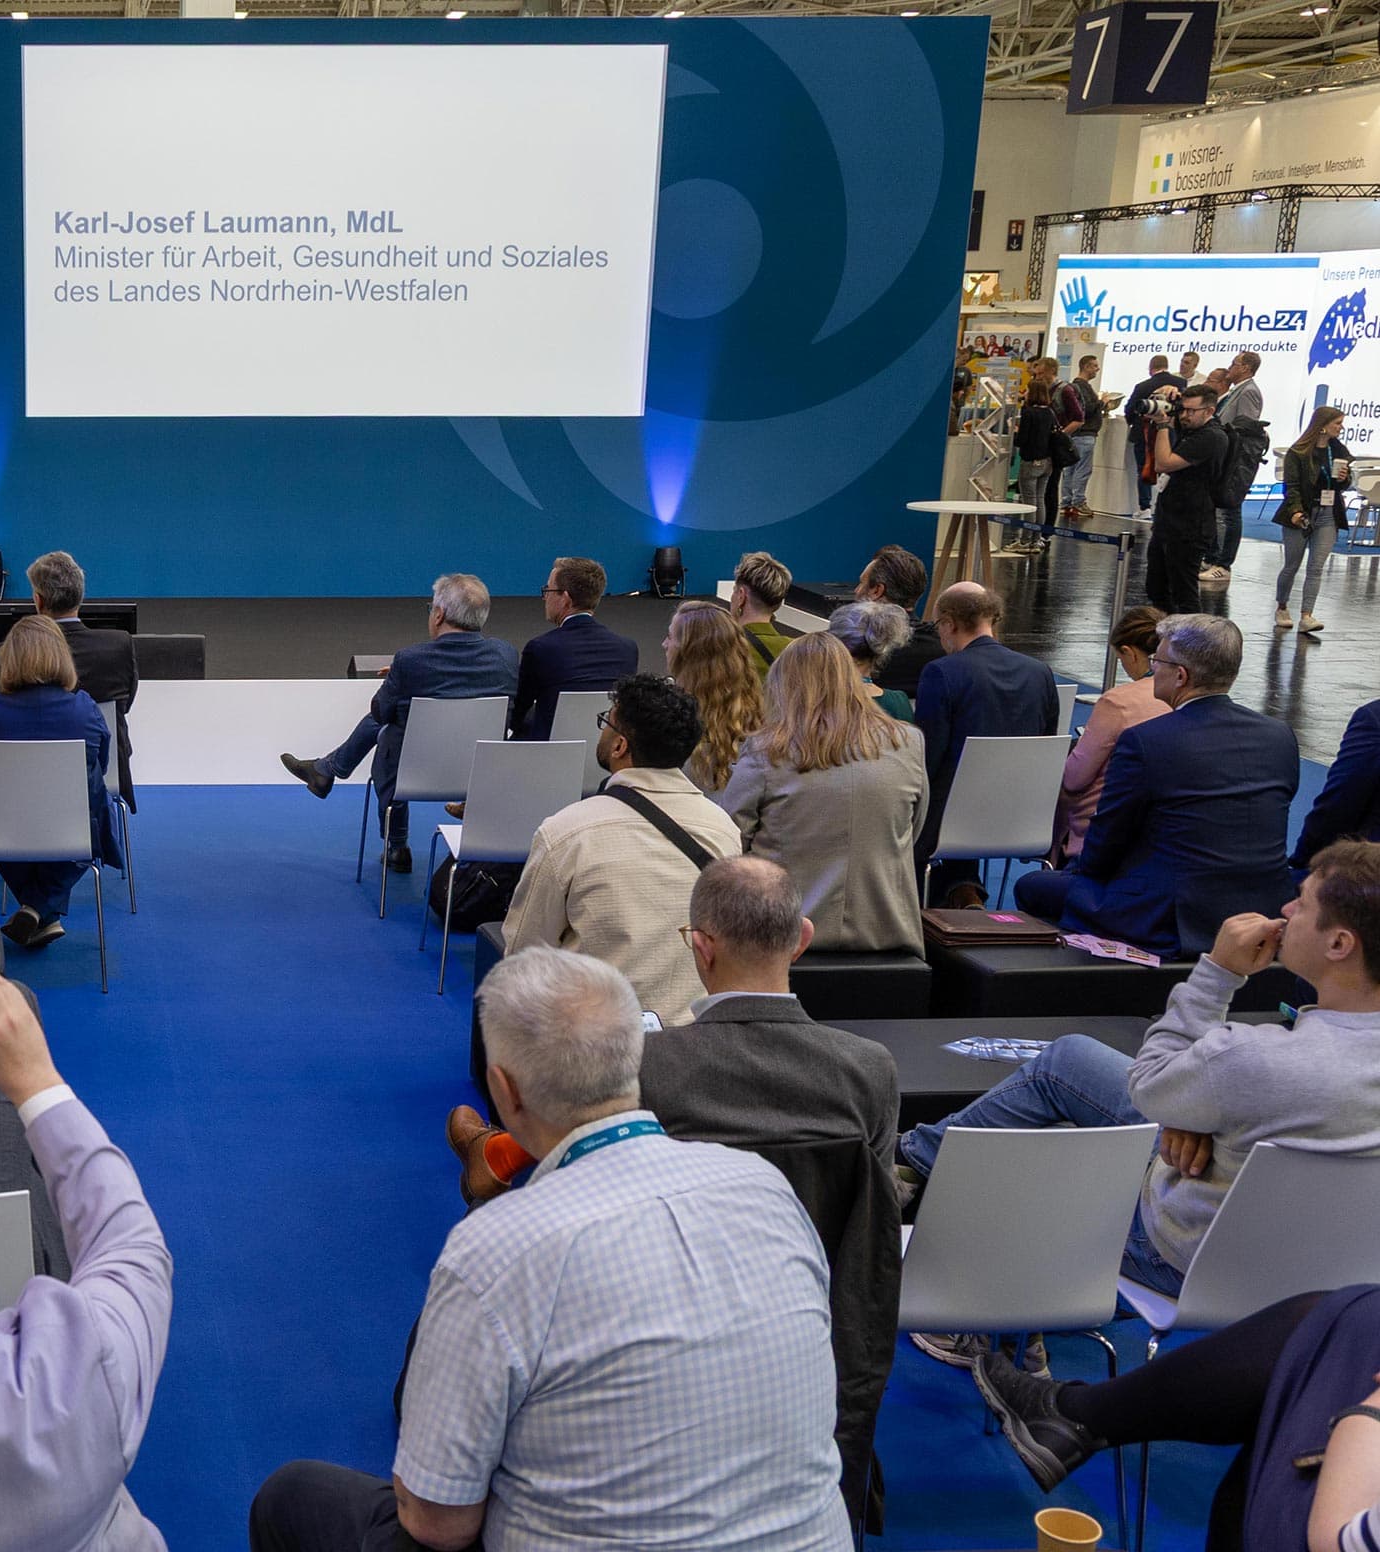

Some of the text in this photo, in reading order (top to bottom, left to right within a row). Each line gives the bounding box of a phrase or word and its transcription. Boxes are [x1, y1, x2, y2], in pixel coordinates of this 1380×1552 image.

[1081, 16, 1110, 100] 7
[1145, 12, 1194, 94] 7
[1179, 144, 1224, 166] wissner-
[1175, 162, 1235, 192] bosserhoff
[54, 210, 403, 237] Karl-Josef Laumann, MdL
[54, 244, 608, 270] Minister für Arbeit, Gesundheit und Soziales
[1323, 268, 1356, 281] Unsere
[54, 279, 468, 302] des Landes Nordrhein-Westfalen
[1113, 340, 1298, 355] Experte für Medizinprodukte
[1338, 423, 1374, 445] apier
